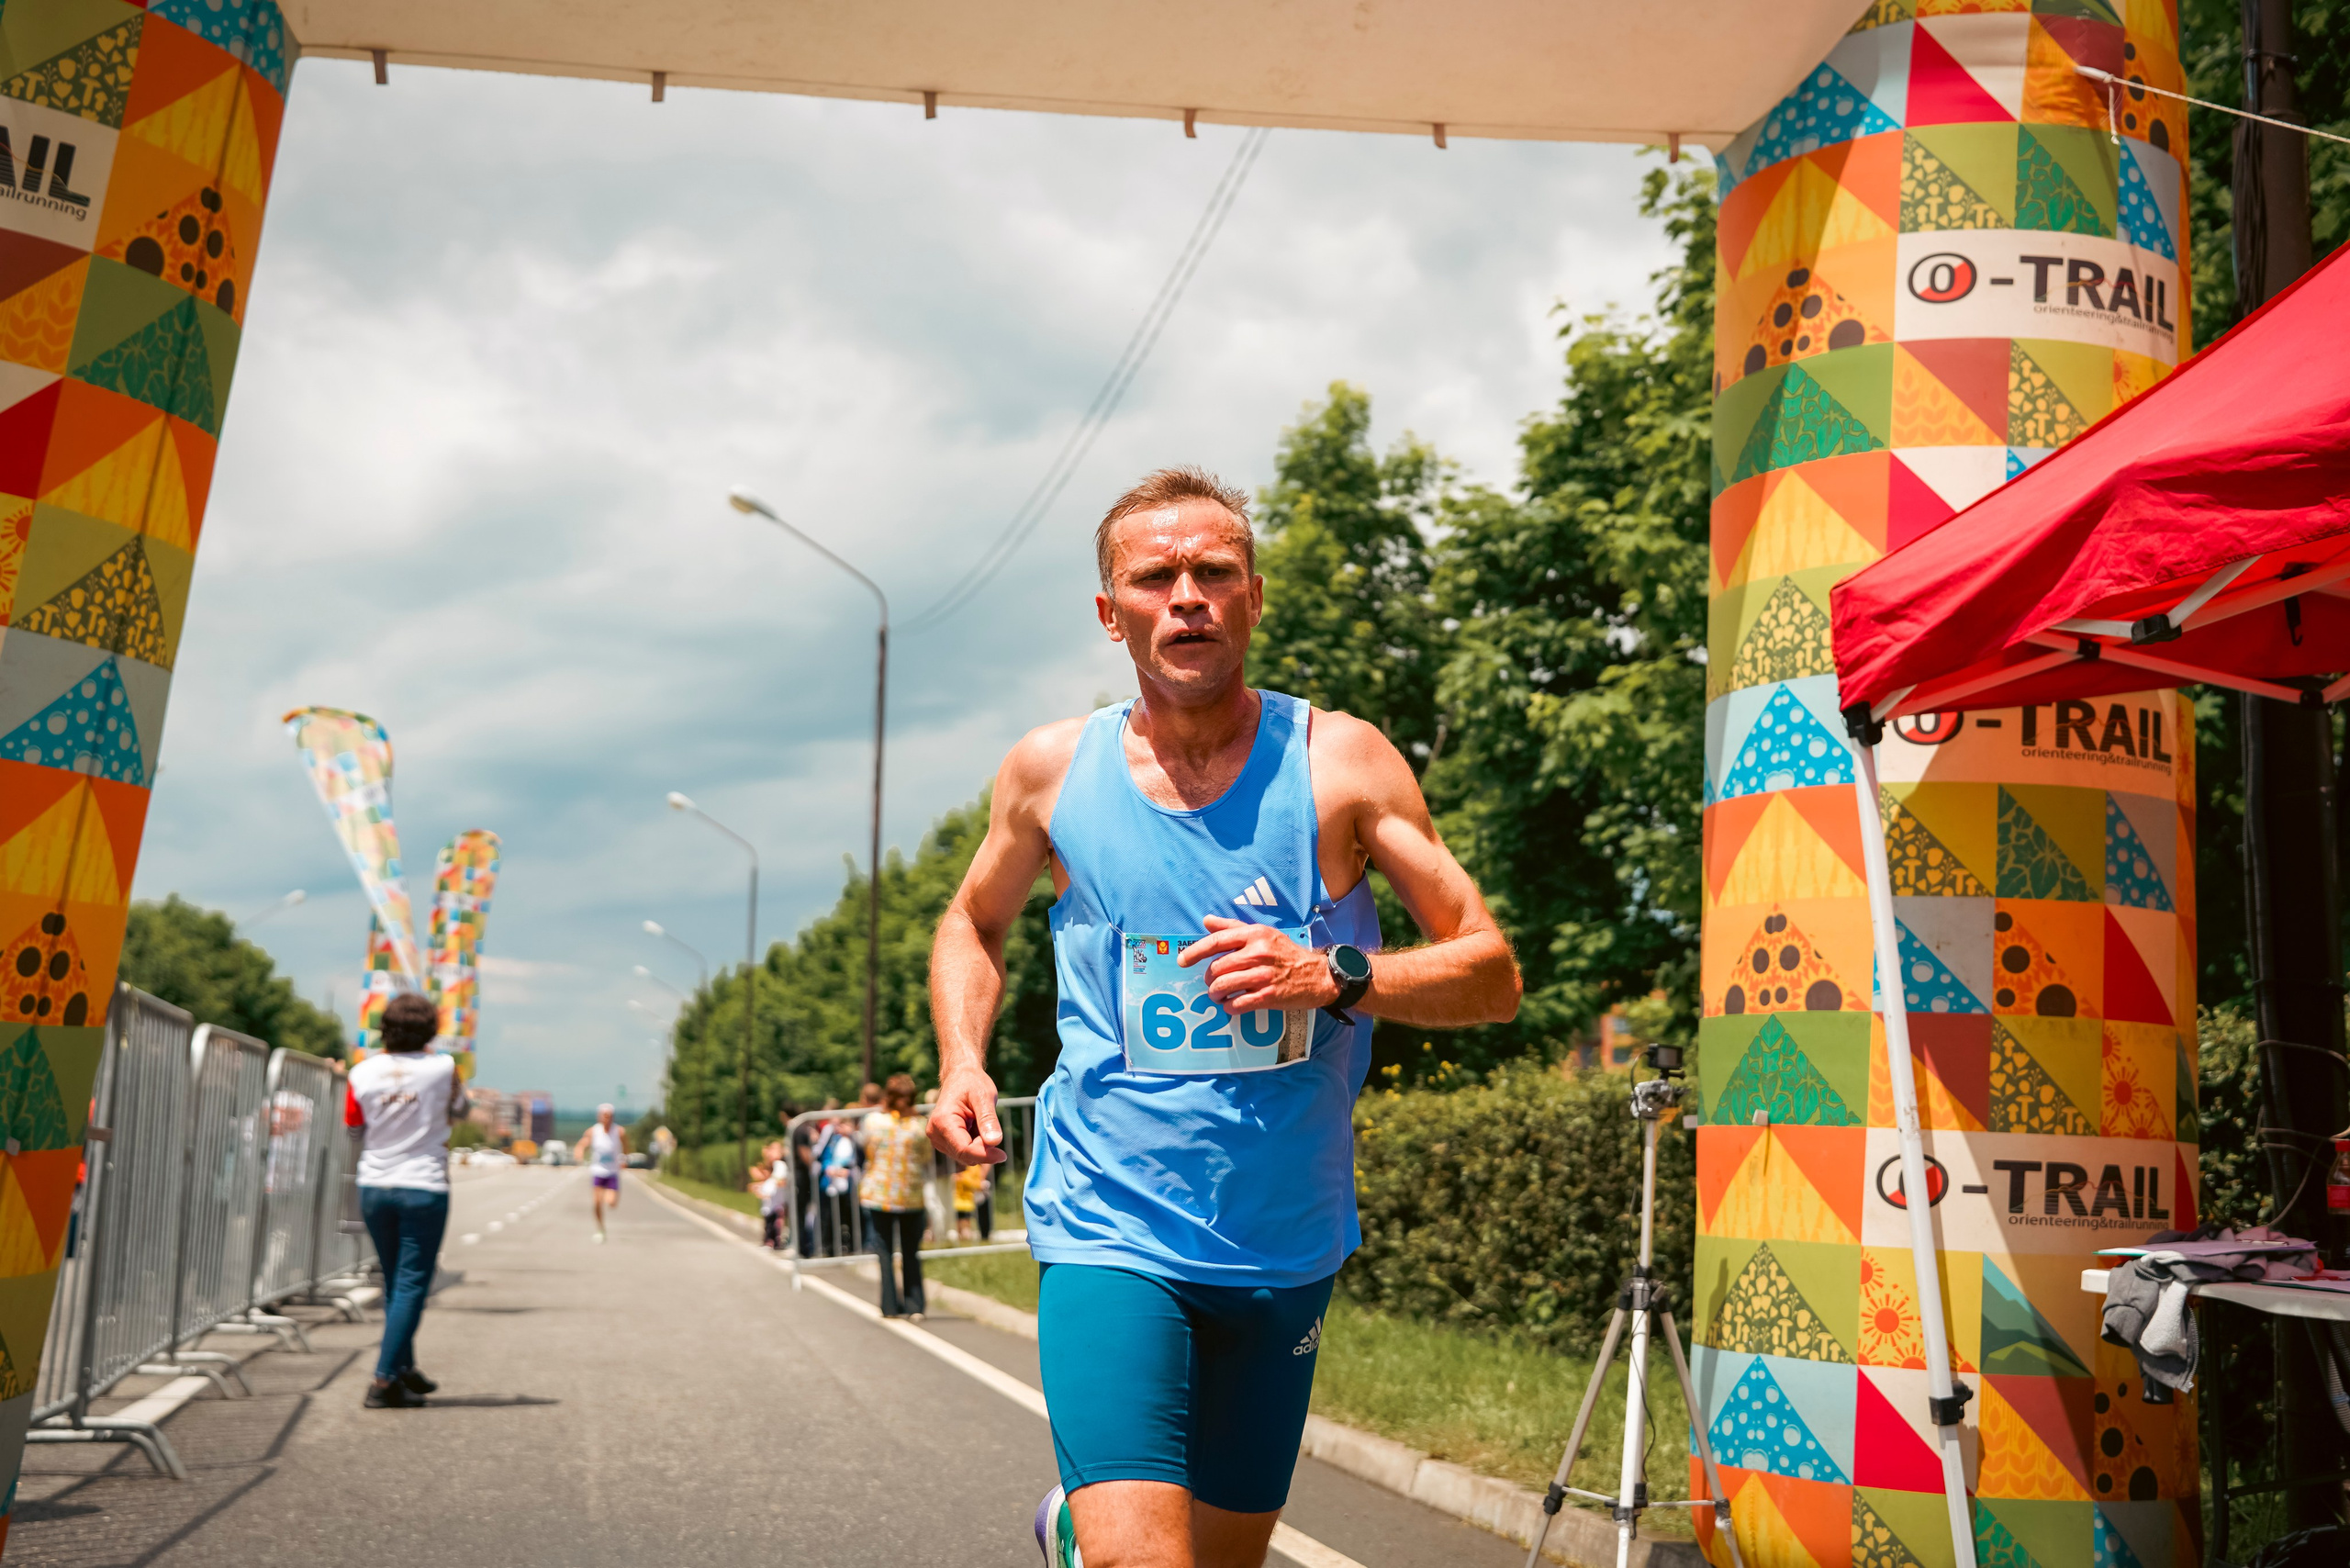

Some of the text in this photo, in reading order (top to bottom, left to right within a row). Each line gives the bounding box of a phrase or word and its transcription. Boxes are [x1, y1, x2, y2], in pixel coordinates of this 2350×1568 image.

[2021, 746, 2172, 777] orienteering&trailrunning
[1141, 992, 1284, 1050] 620
[2008, 1215, 2170, 1230] orienteering&trailrunning
